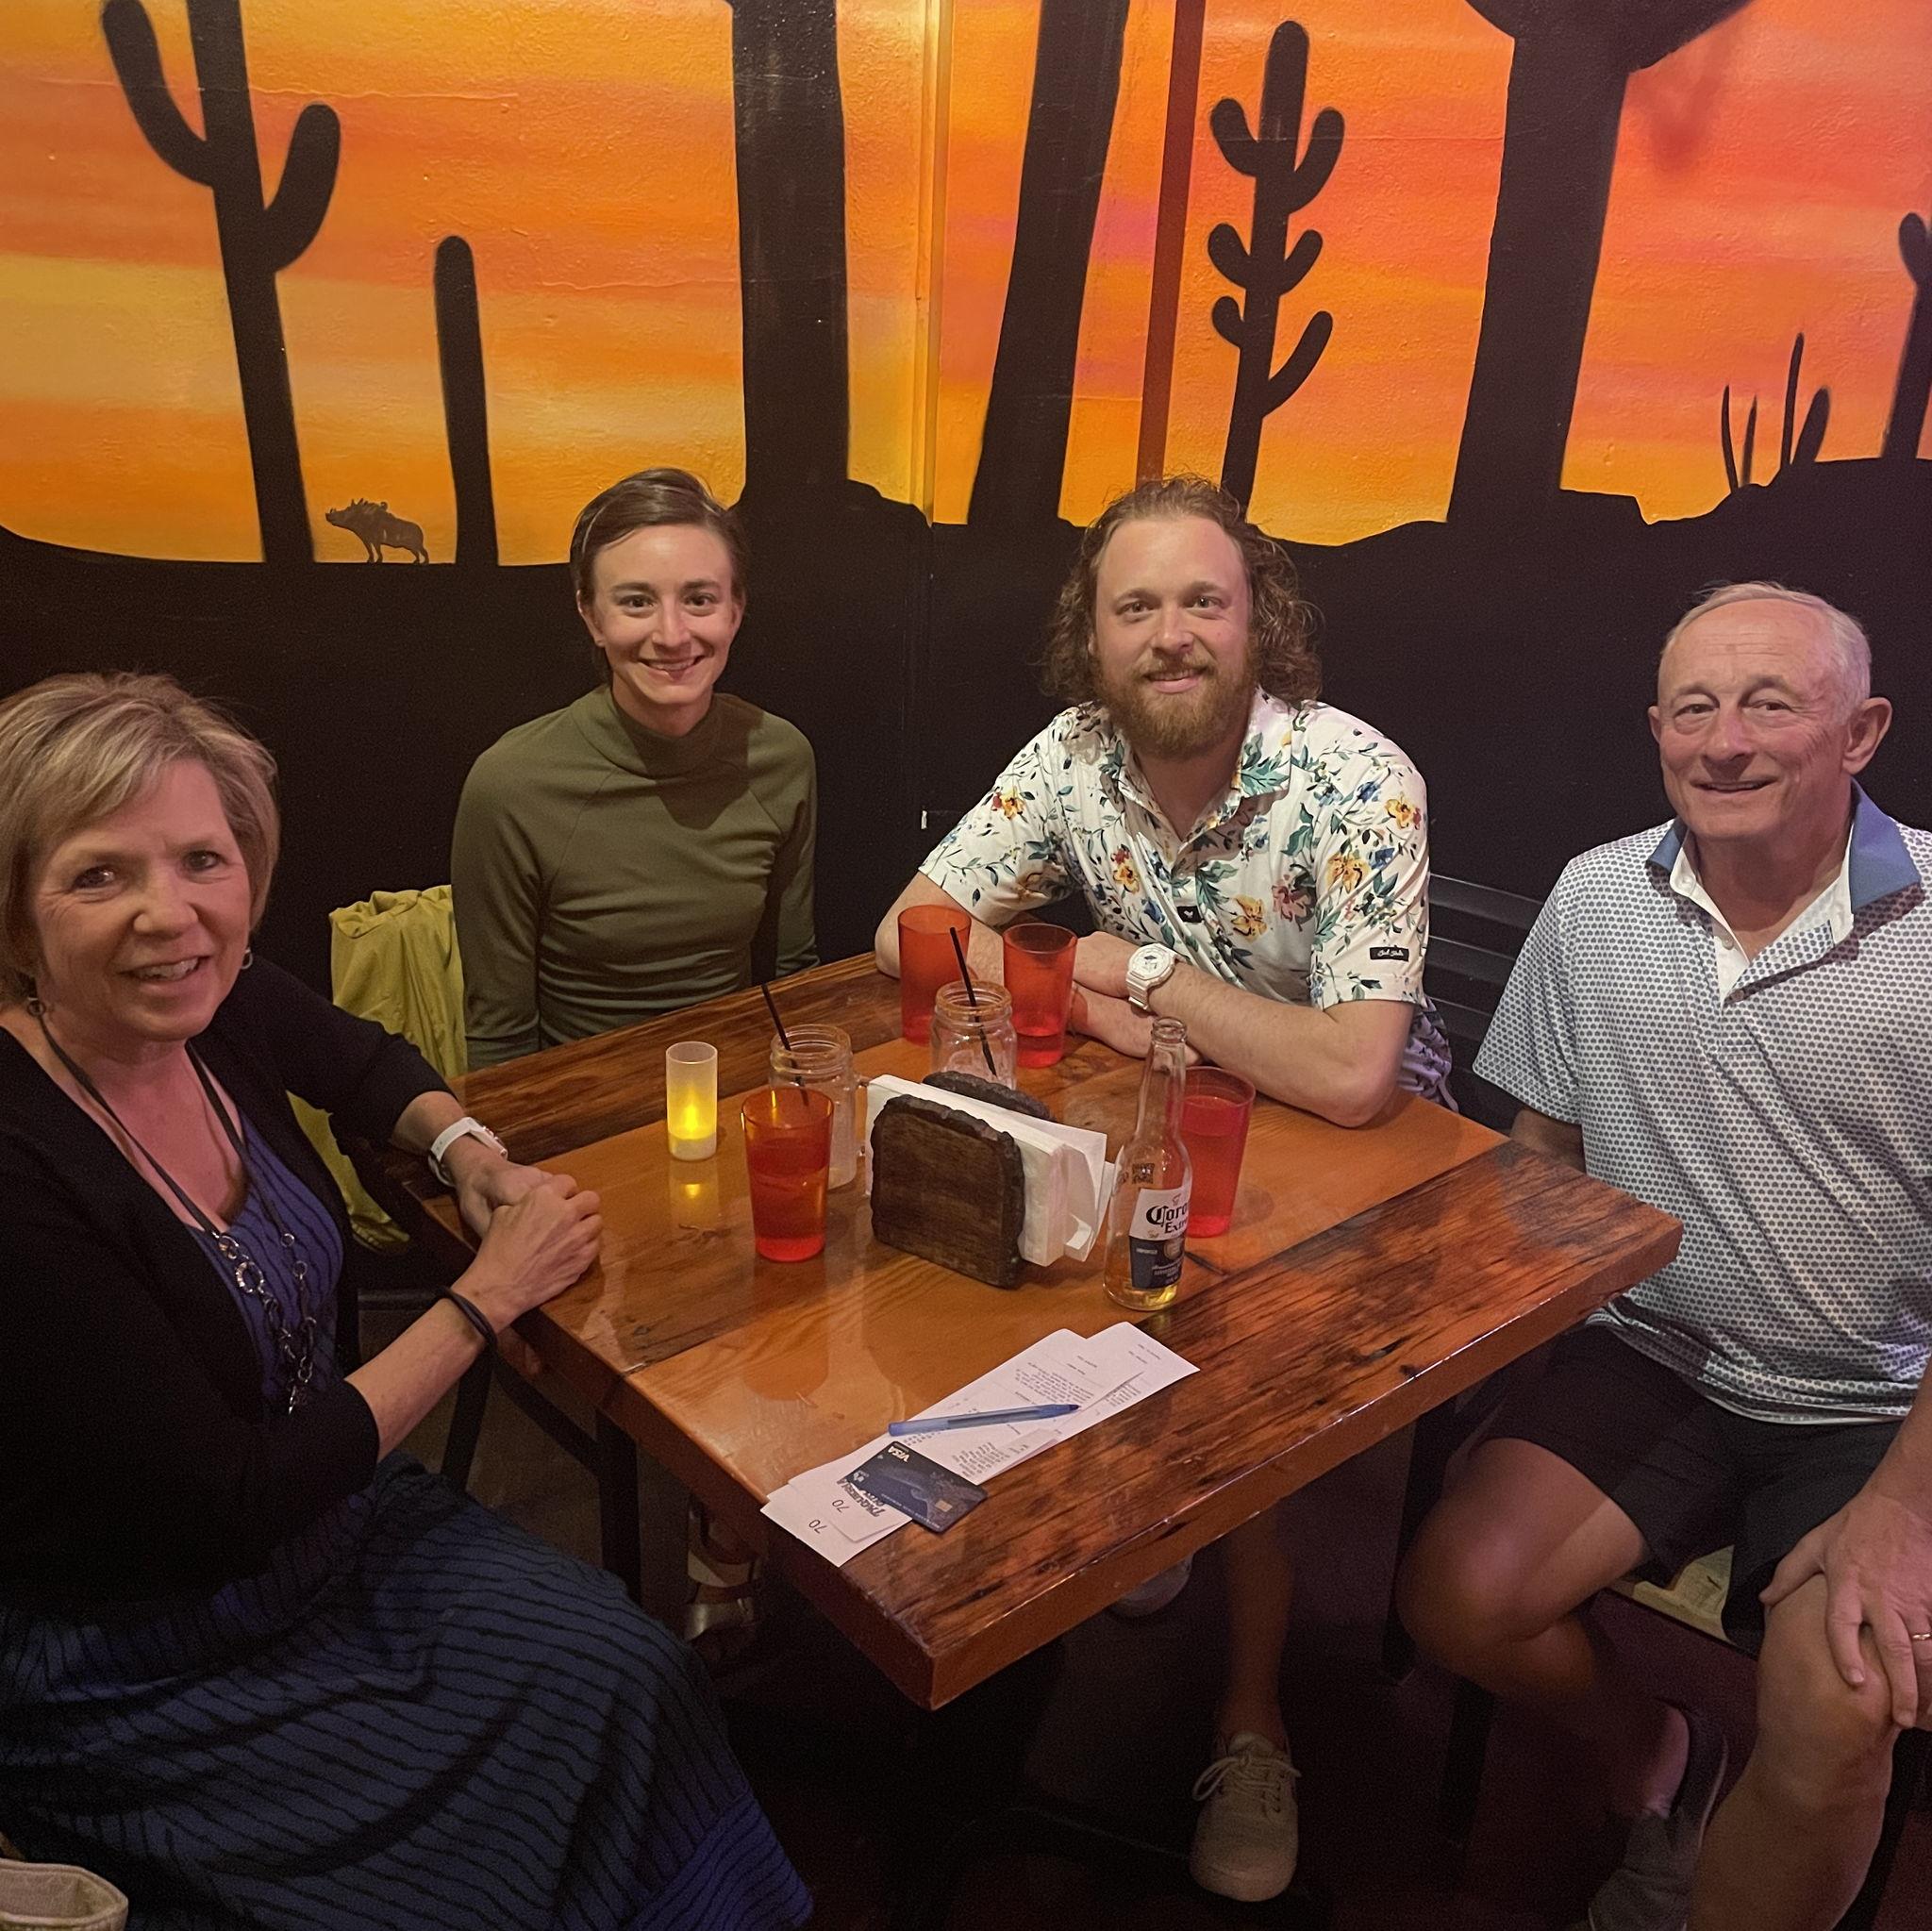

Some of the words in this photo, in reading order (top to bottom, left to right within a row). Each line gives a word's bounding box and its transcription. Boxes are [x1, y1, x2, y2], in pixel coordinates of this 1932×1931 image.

[1145, 1203, 1188, 1227] Coro
[888, 1446, 910, 1462] VISA
[832, 1499, 850, 1513] 70
[808, 1519, 827, 1534] 70
